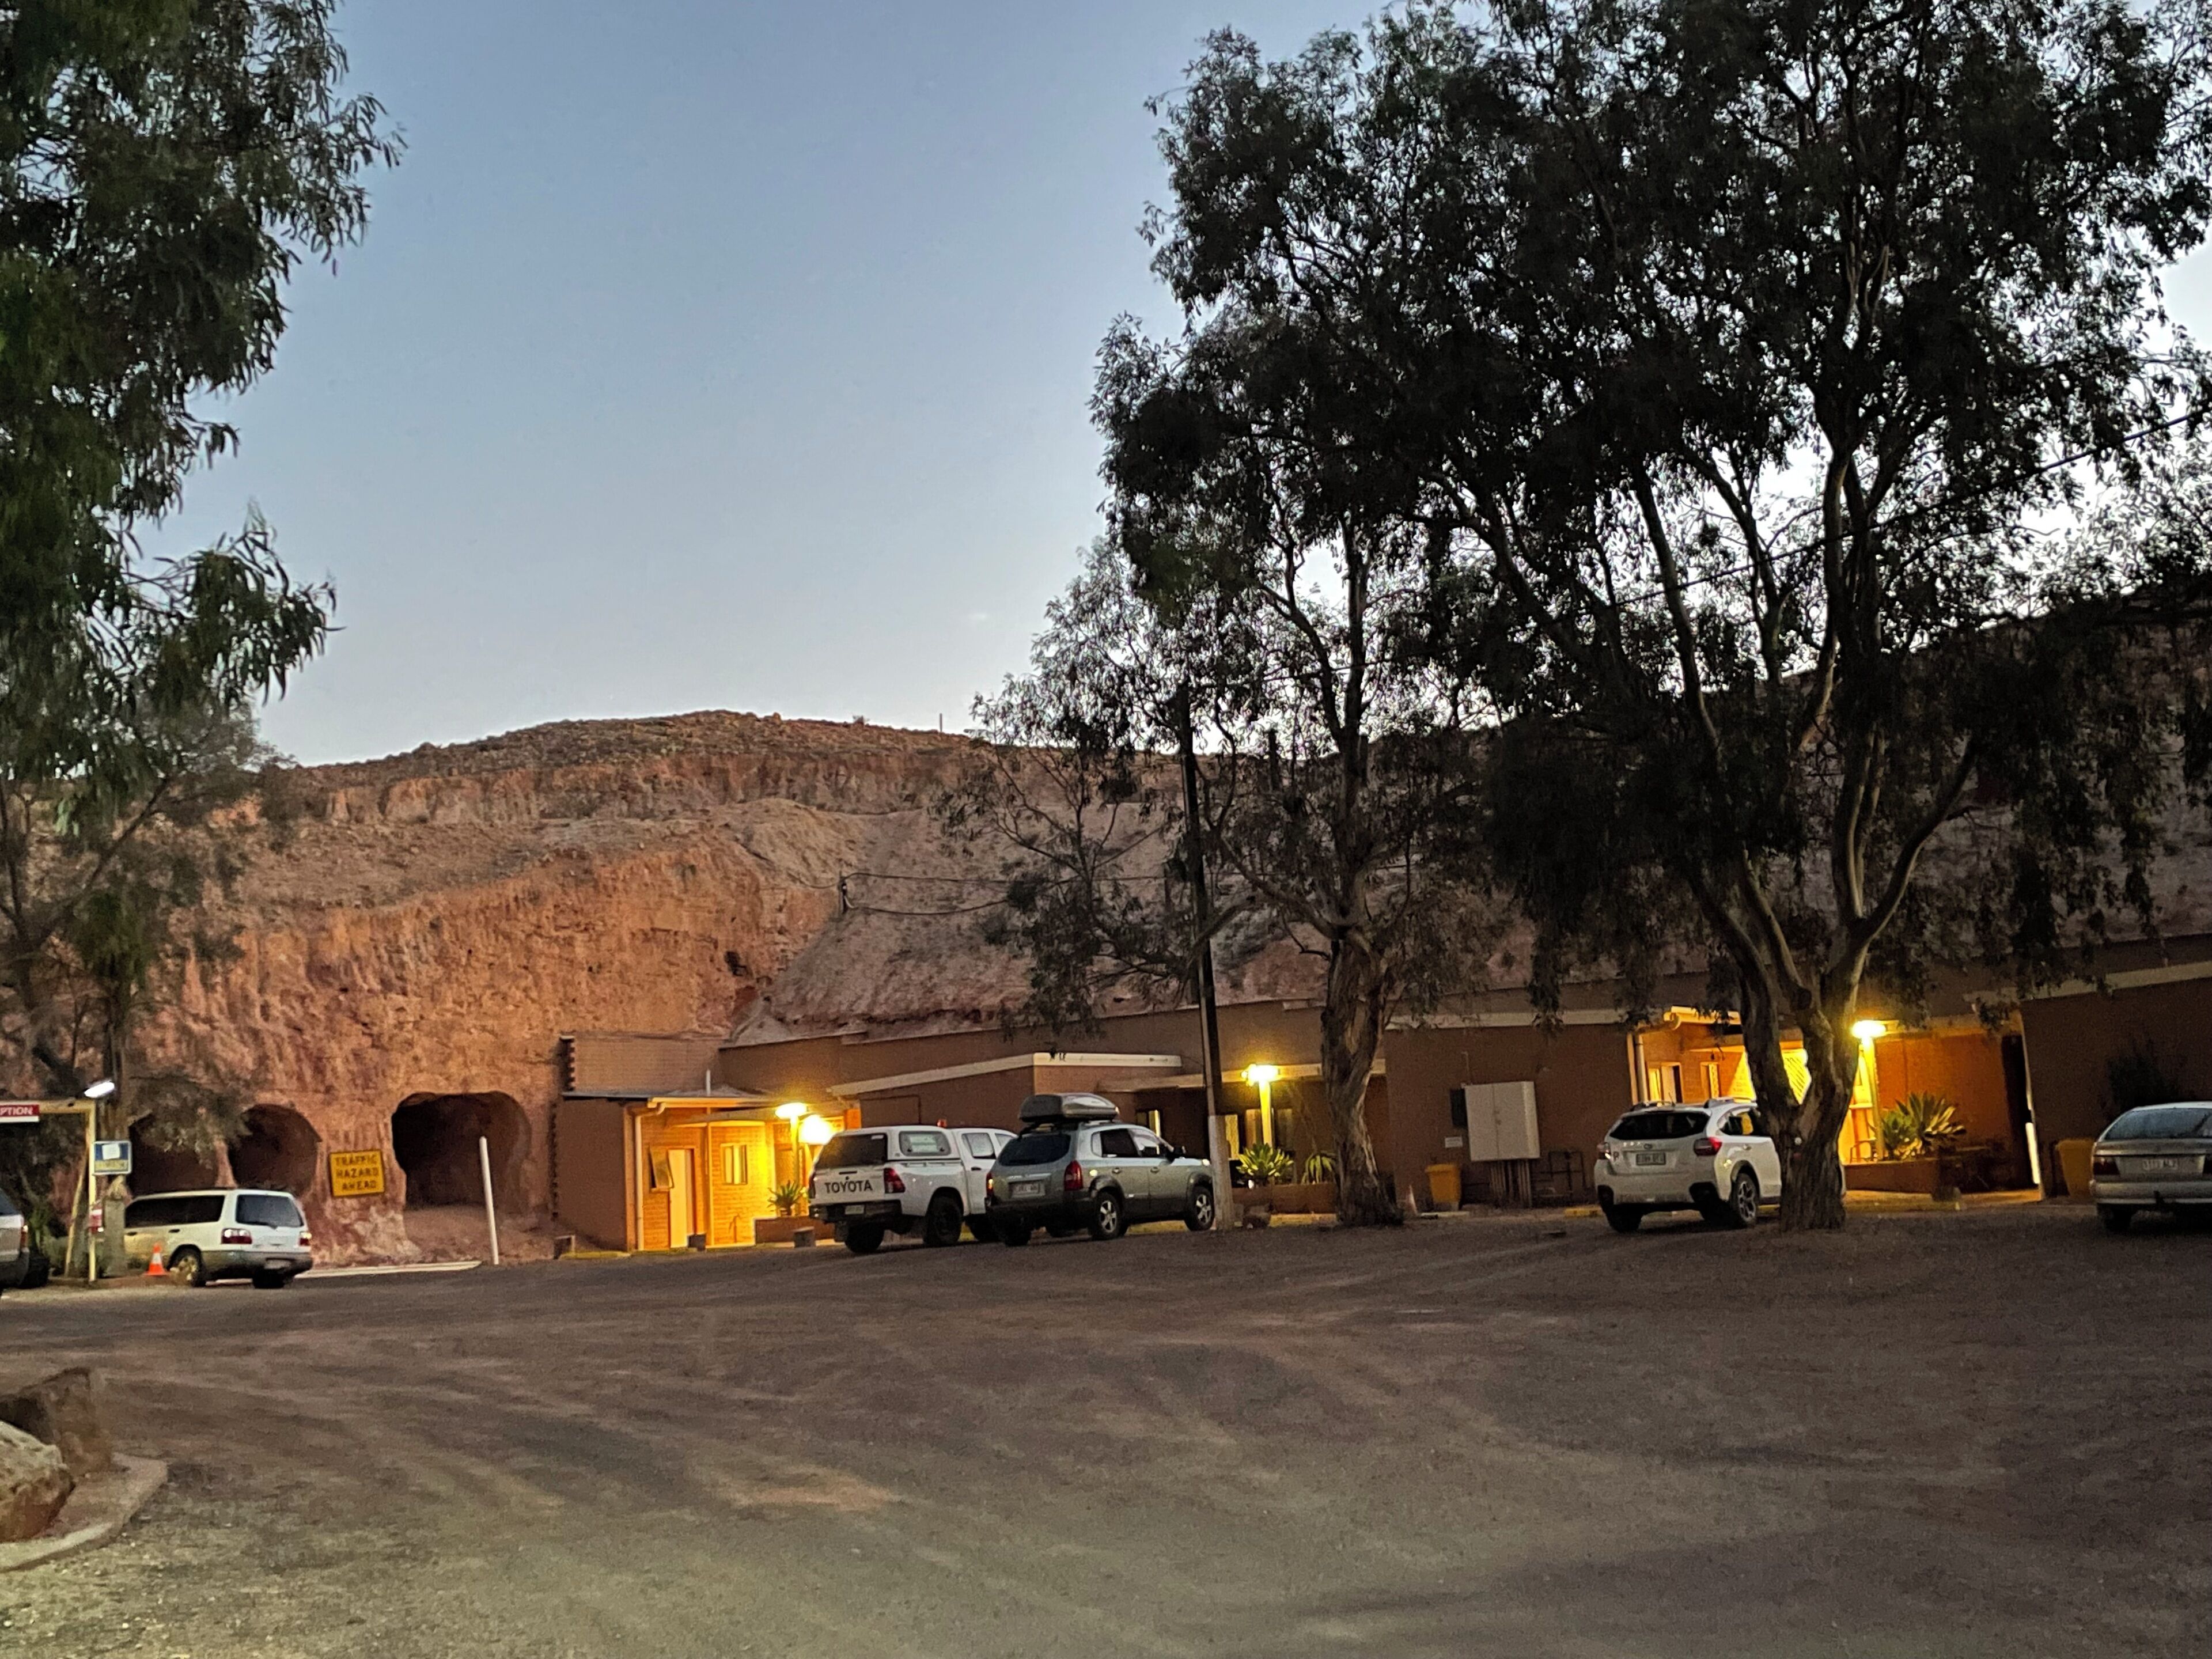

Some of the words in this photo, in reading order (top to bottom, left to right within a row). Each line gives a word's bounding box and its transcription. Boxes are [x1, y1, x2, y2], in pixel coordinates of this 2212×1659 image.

[335, 1154, 377, 1166] TRAFFIC
[336, 1168, 379, 1179] HAZARD
[342, 1180, 377, 1191] AHEAD
[824, 1179, 873, 1194] TOYOTA
